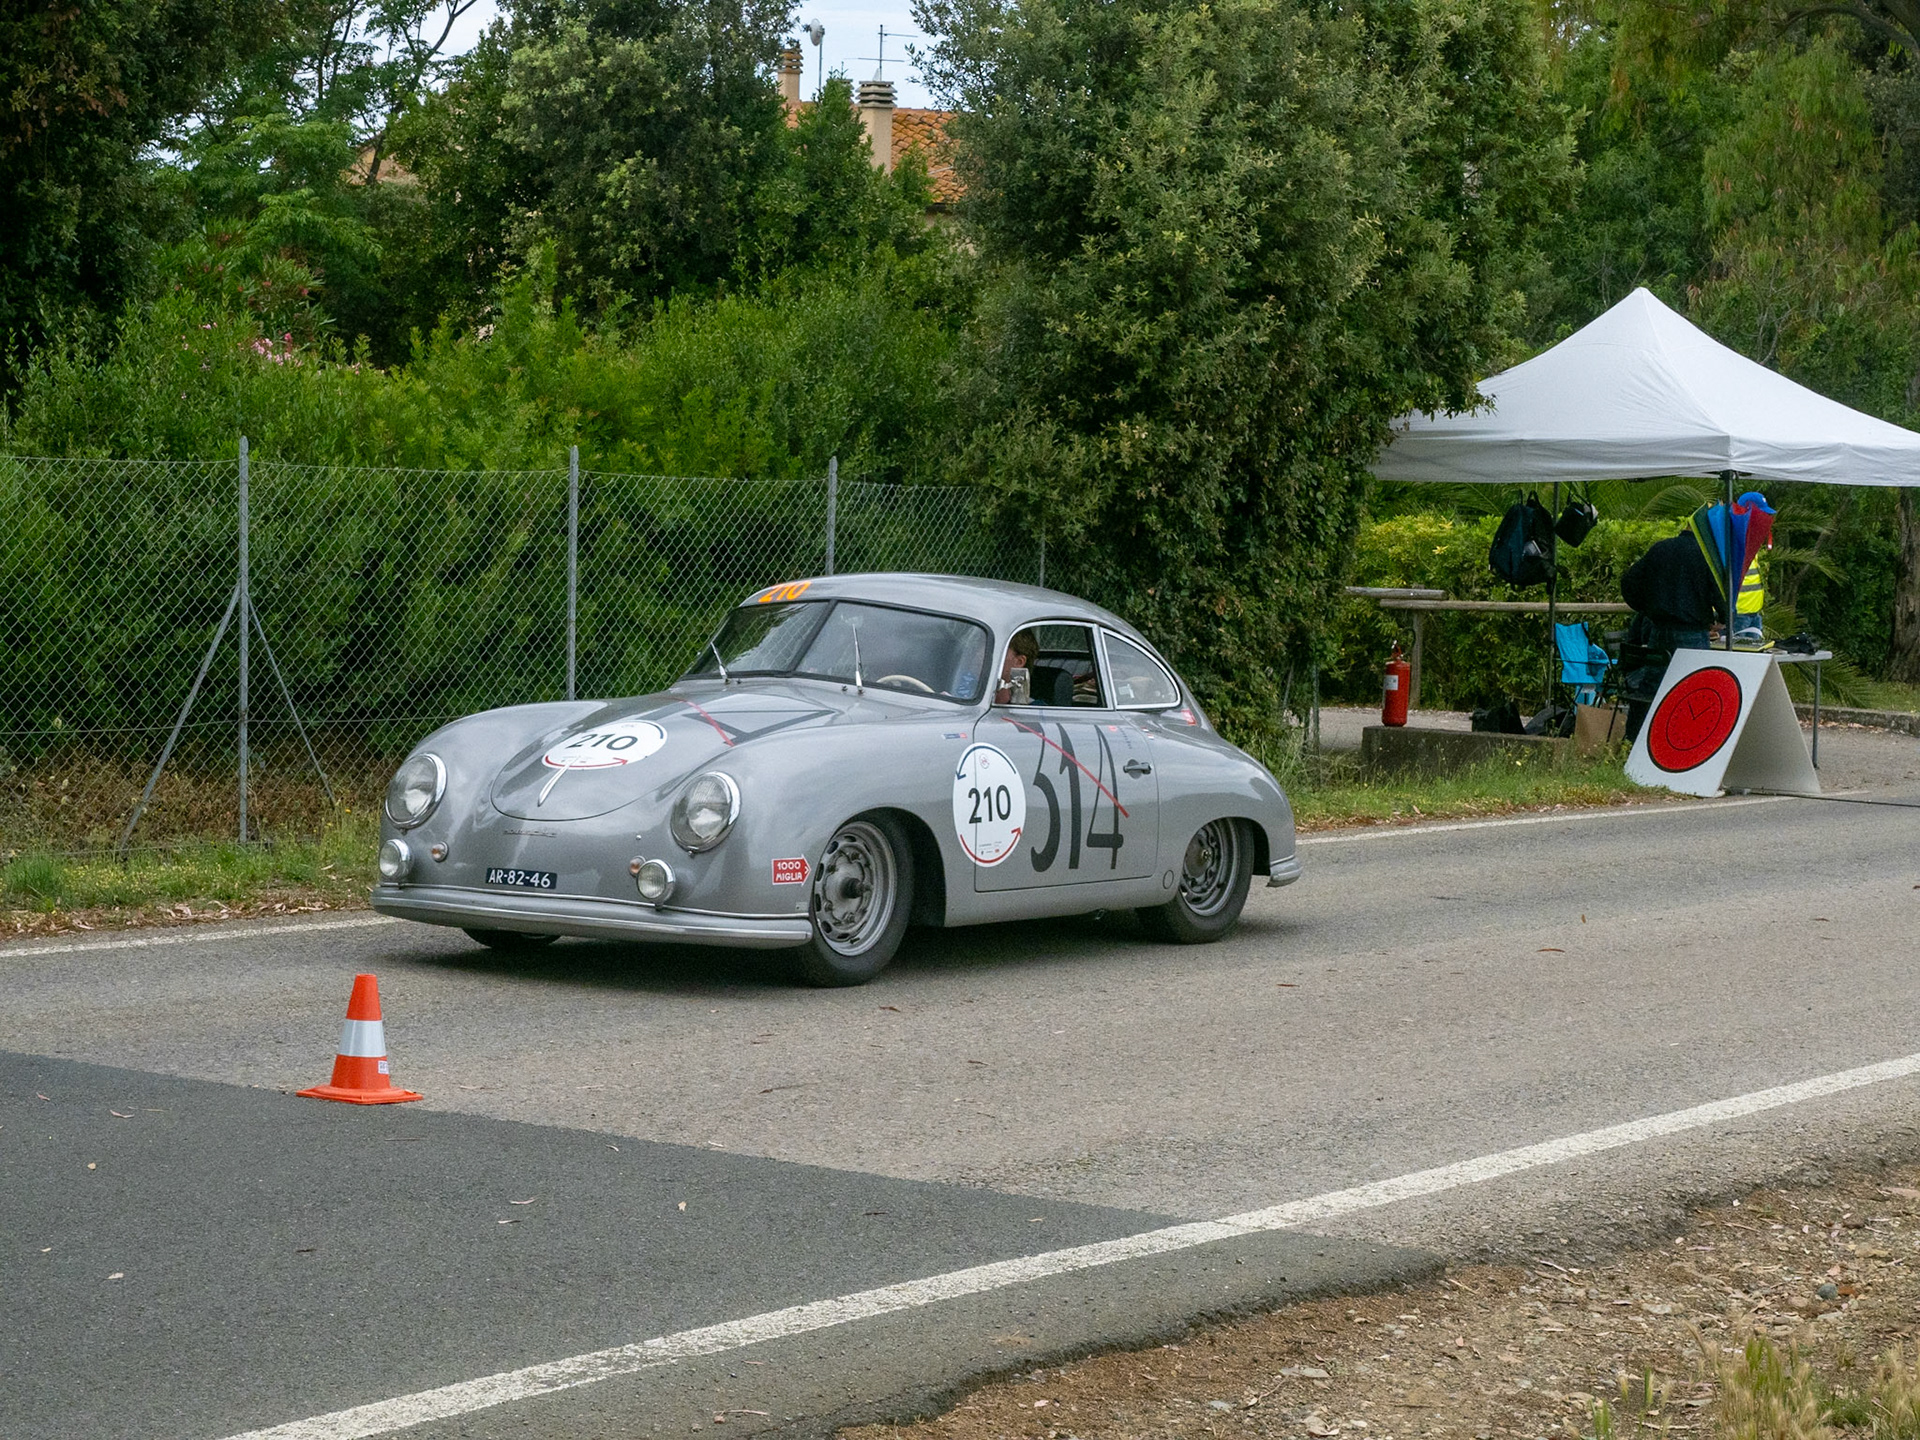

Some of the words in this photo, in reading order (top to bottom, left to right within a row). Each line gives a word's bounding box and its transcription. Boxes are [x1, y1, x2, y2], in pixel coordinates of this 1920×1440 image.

[758, 580, 812, 603] 210
[565, 733, 639, 751] 210
[968, 784, 1012, 825] 210
[1014, 721, 1124, 873] 314
[777, 861, 801, 871] 1000
[488, 869, 551, 888] AR-82-46
[775, 872, 803, 882] MIGLIA
